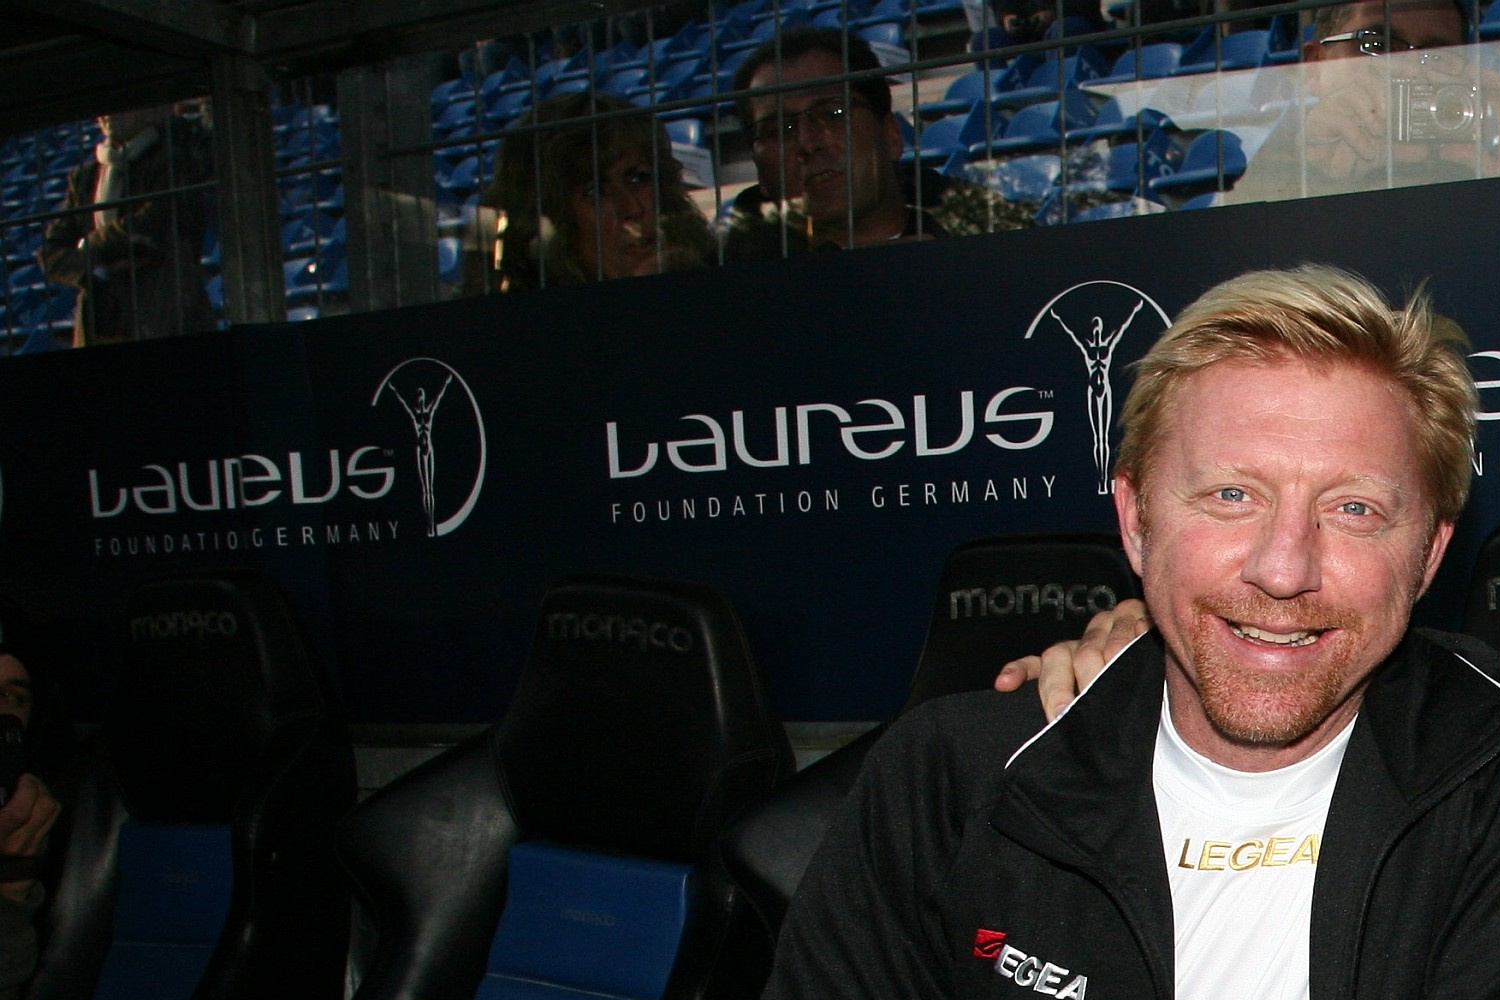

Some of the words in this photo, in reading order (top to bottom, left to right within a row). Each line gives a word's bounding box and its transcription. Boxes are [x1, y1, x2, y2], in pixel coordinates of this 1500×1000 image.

[612, 488, 840, 523] FOUNDATION
[871, 475, 1058, 508] GERMANY
[95, 529, 240, 557] FOUNDATIO
[251, 520, 399, 548] GERMANY
[1177, 833, 1320, 871] LEGEA
